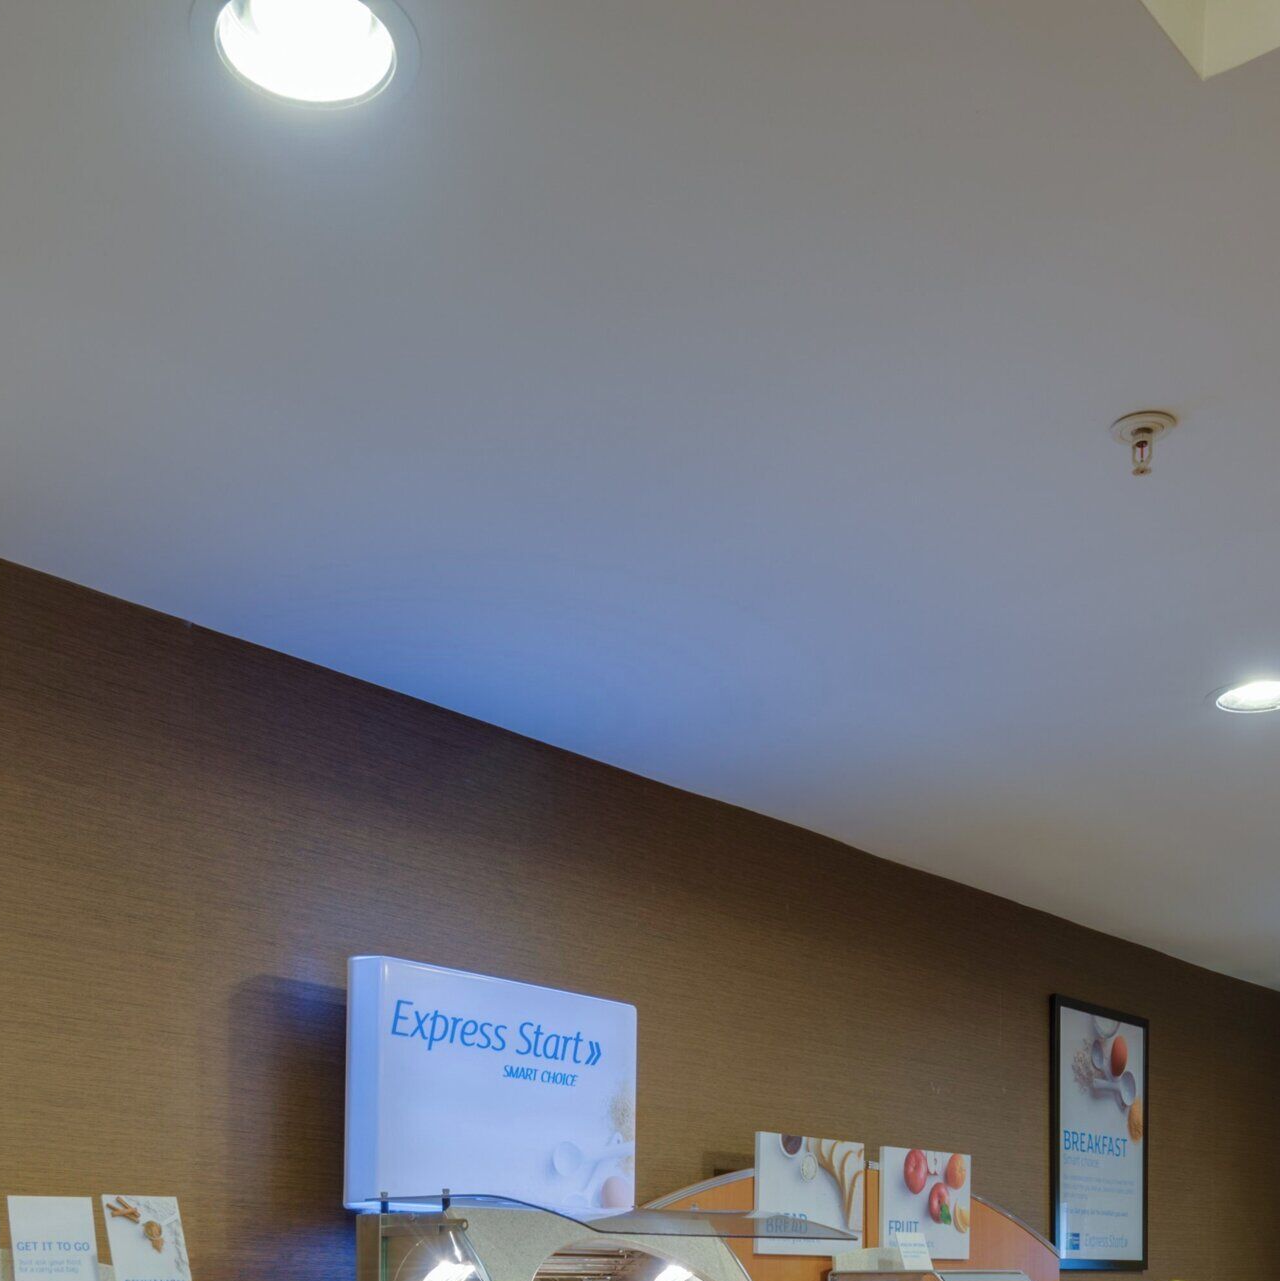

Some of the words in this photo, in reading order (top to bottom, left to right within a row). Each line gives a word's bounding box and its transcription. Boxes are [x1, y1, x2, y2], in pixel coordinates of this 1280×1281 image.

[391, 1000, 507, 1051] Express
[516, 1021, 583, 1064] Start
[503, 1065, 539, 1081] SMART
[540, 1070, 578, 1087] CHOICE
[1063, 1130, 1127, 1157] BREAKFAST
[888, 1220, 919, 1235] FRUIT
[16, 1241, 38, 1251] GET
[42, 1241, 52, 1251] IT
[56, 1241, 71, 1251] TO
[74, 1241, 90, 1251] GO
